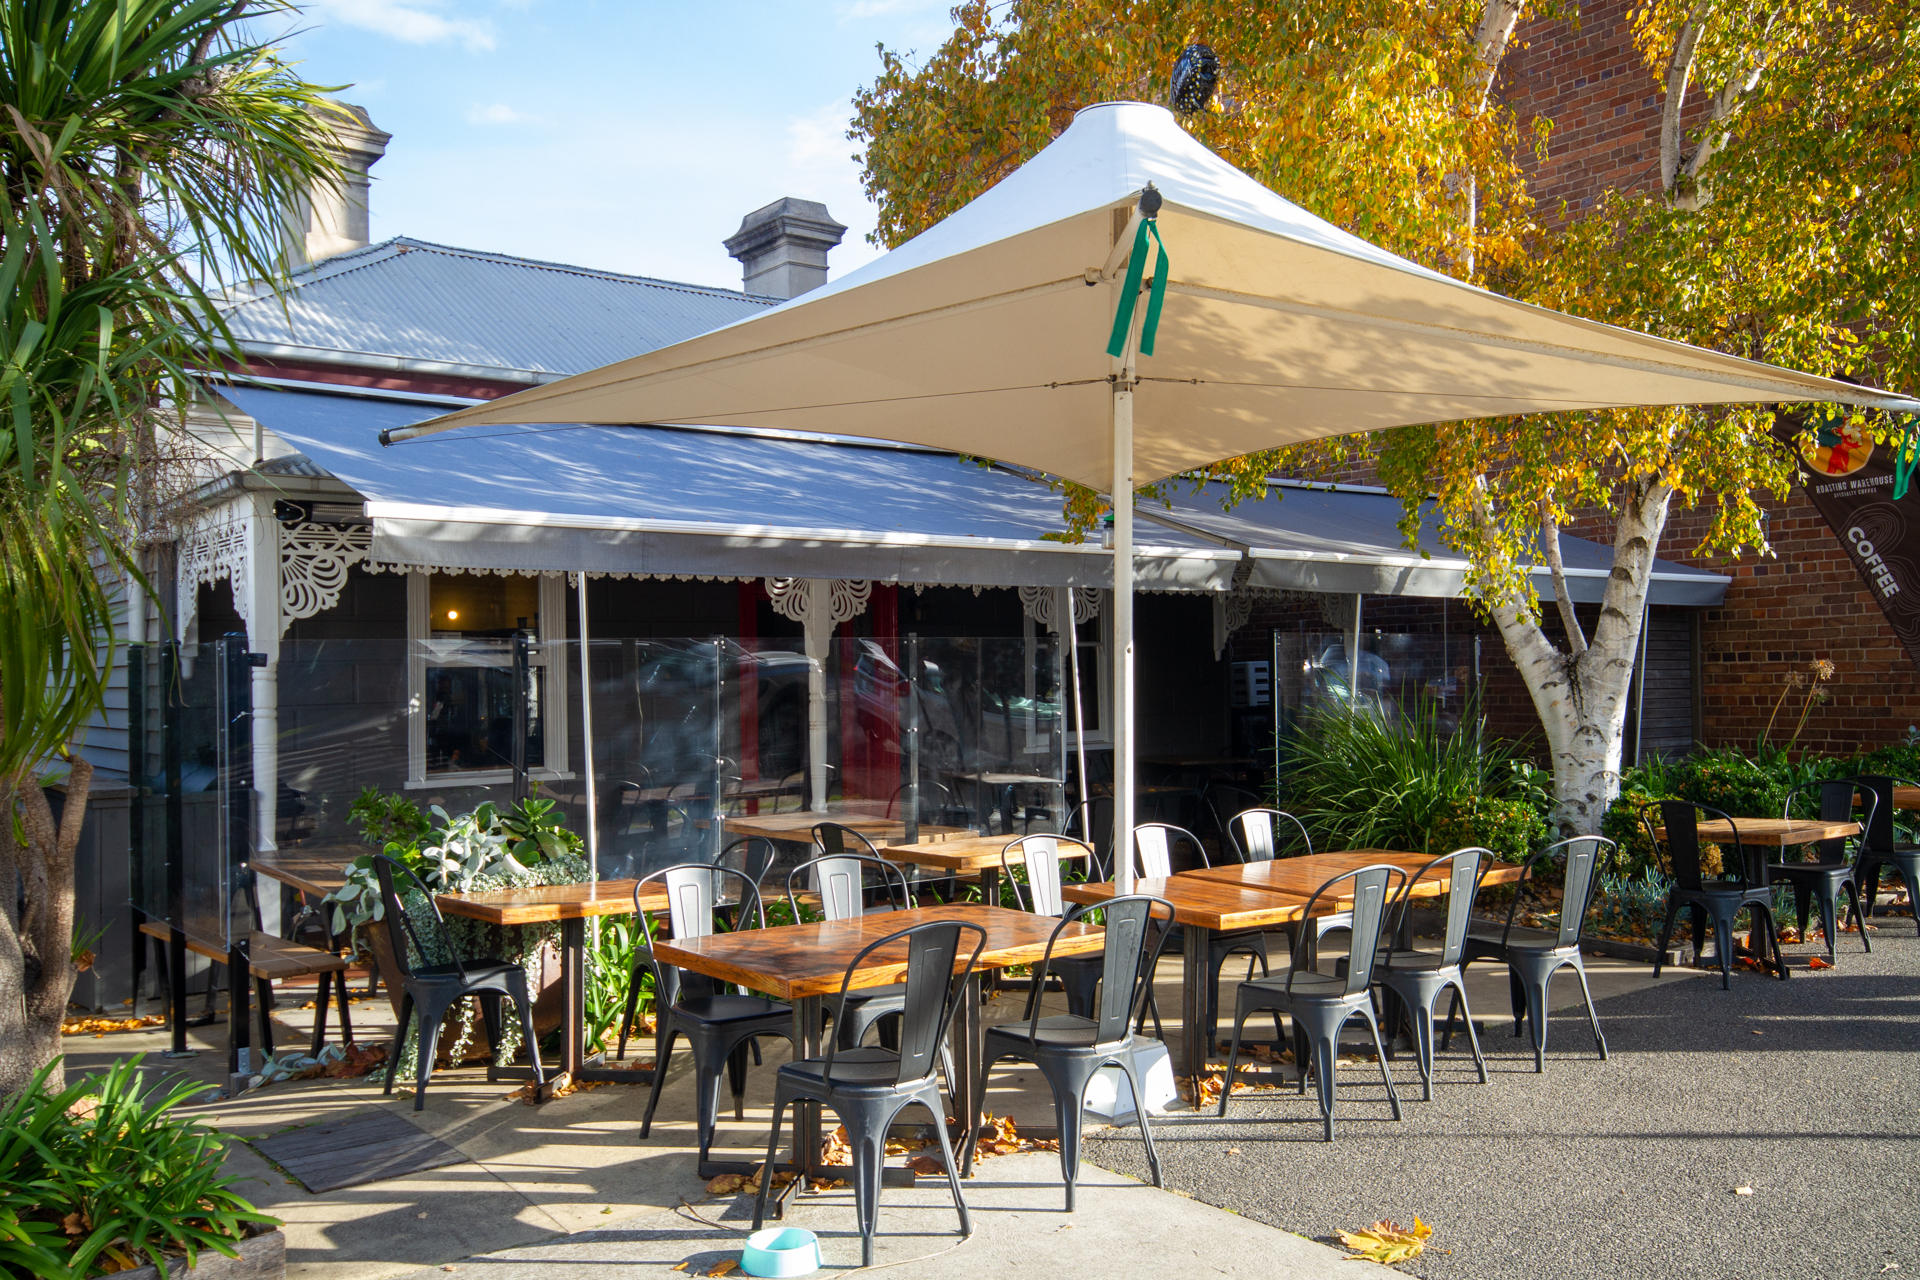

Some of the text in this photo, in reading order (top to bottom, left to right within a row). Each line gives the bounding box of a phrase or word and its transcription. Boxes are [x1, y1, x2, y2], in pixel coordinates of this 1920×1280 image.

[1816, 475, 1893, 494] ROASTING WAREHOUSE
[1858, 487, 1877, 495] COFFEE
[1848, 526, 1900, 598] COFFEE
